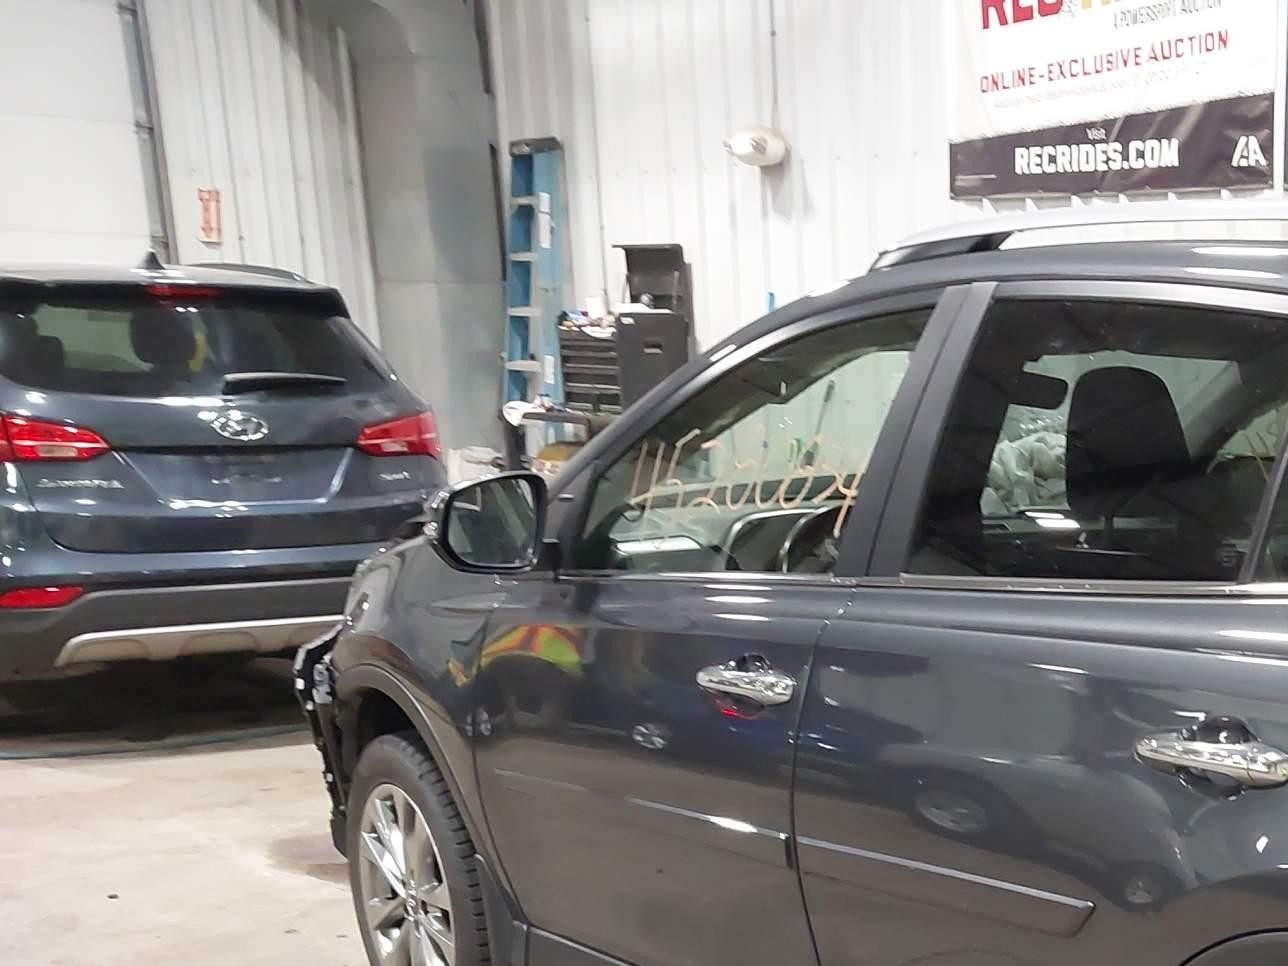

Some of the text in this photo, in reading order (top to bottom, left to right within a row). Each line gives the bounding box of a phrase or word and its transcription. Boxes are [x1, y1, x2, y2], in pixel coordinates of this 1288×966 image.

[979, 45, 1143, 94] ONLINE-EXCLUSIVE
[1146, 28, 1229, 63] AUCTION
[1014, 137, 1180, 175] RECRIDES.COM
